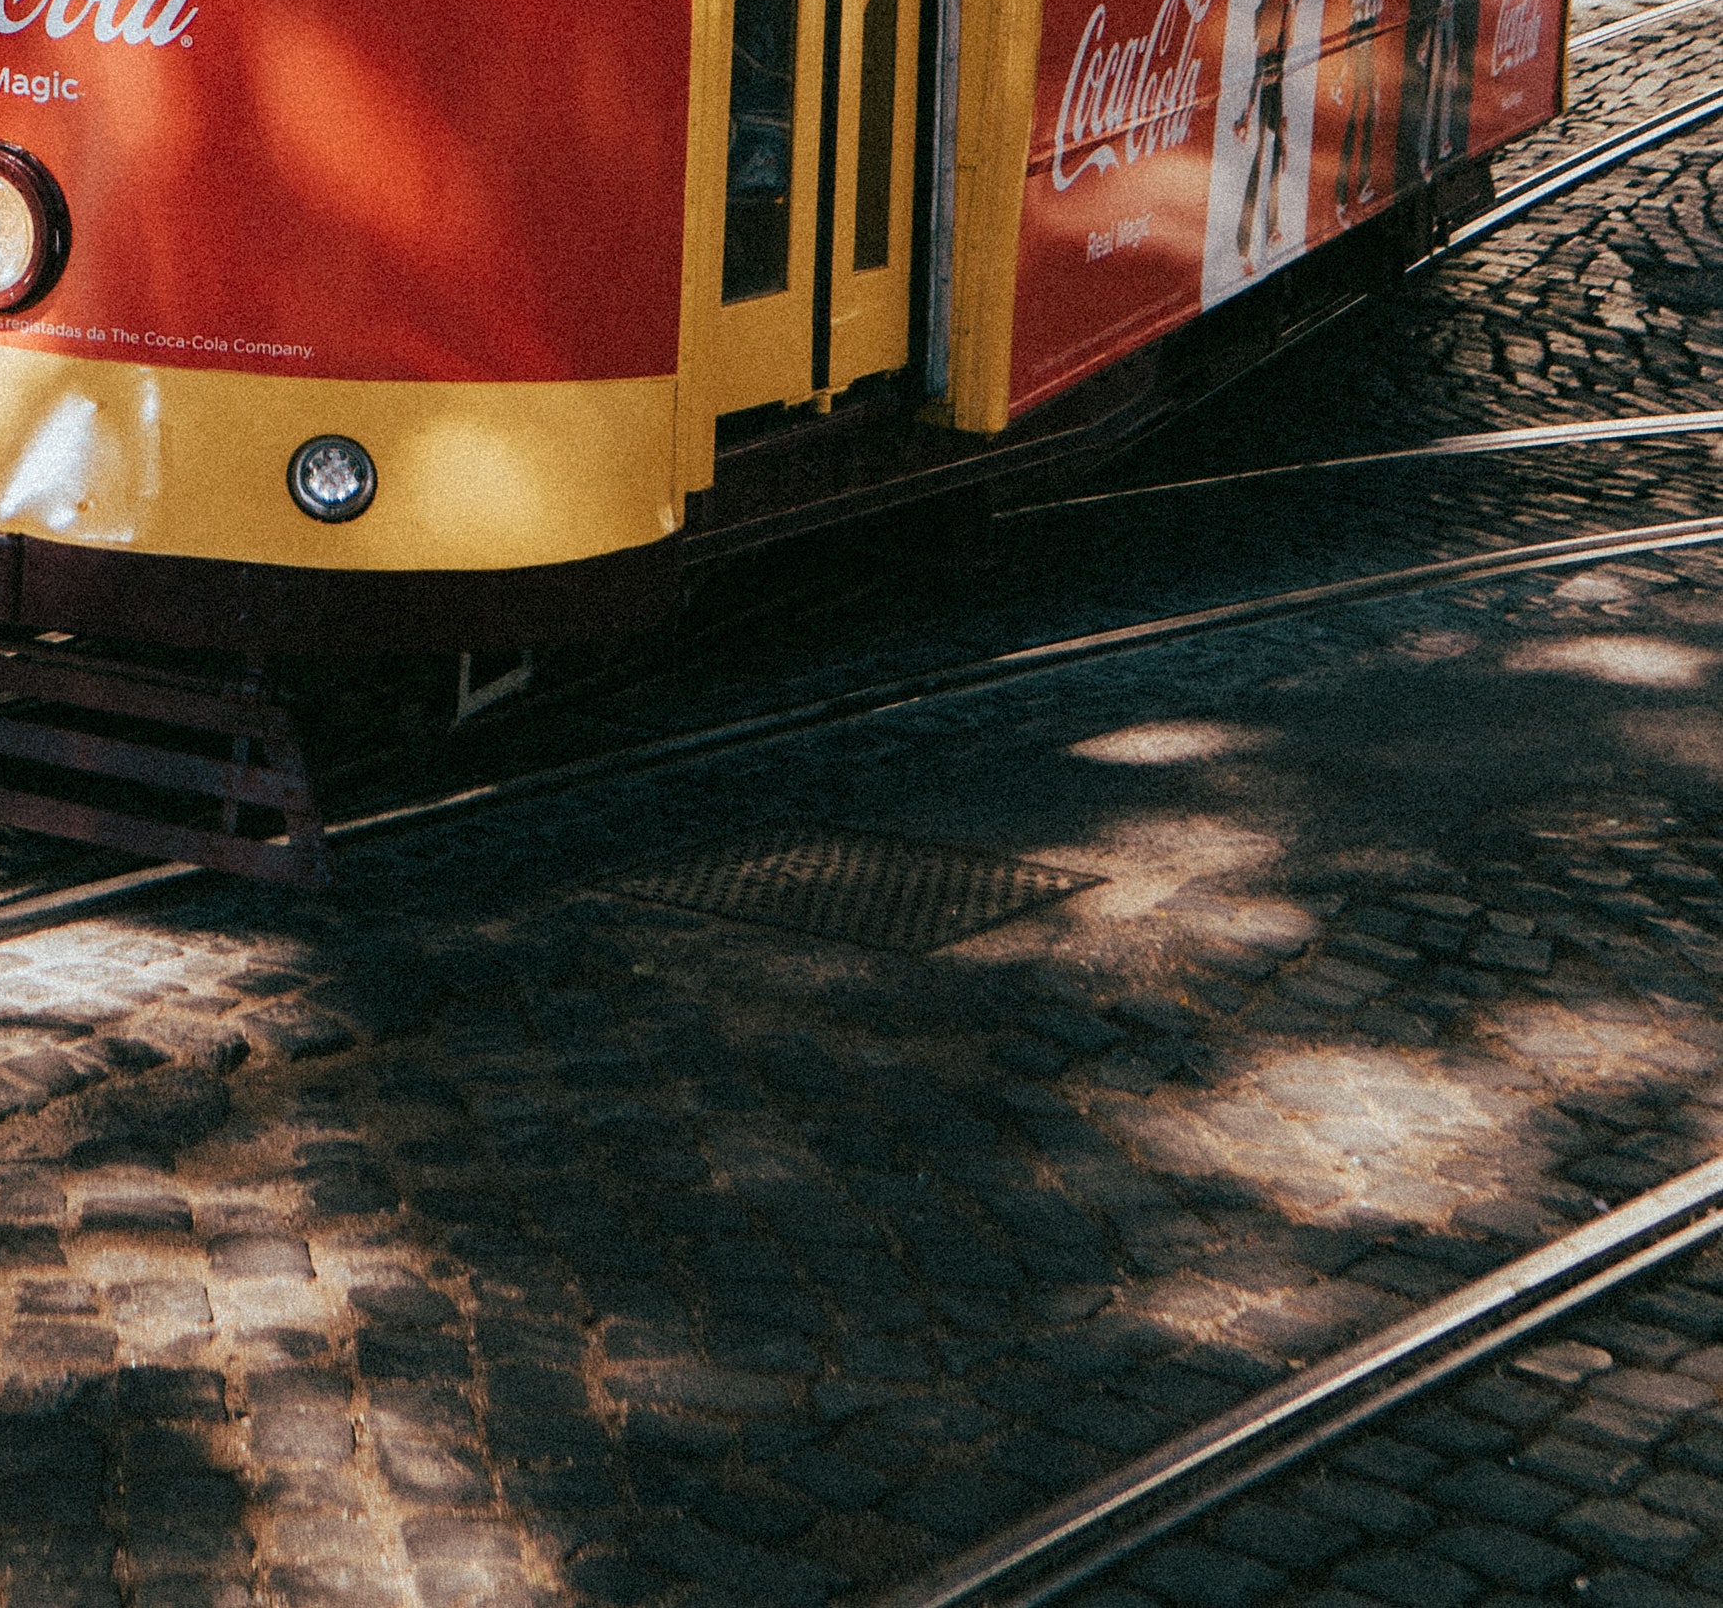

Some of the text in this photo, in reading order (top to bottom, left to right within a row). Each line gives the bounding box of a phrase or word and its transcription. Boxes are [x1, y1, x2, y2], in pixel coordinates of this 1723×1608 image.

[5, 317, 82, 339] registadas
[85, 325, 106, 342] da
[110, 327, 140, 345] The
[144, 331, 229, 352] Coca-Cola
[232, 337, 316, 359] Company.
